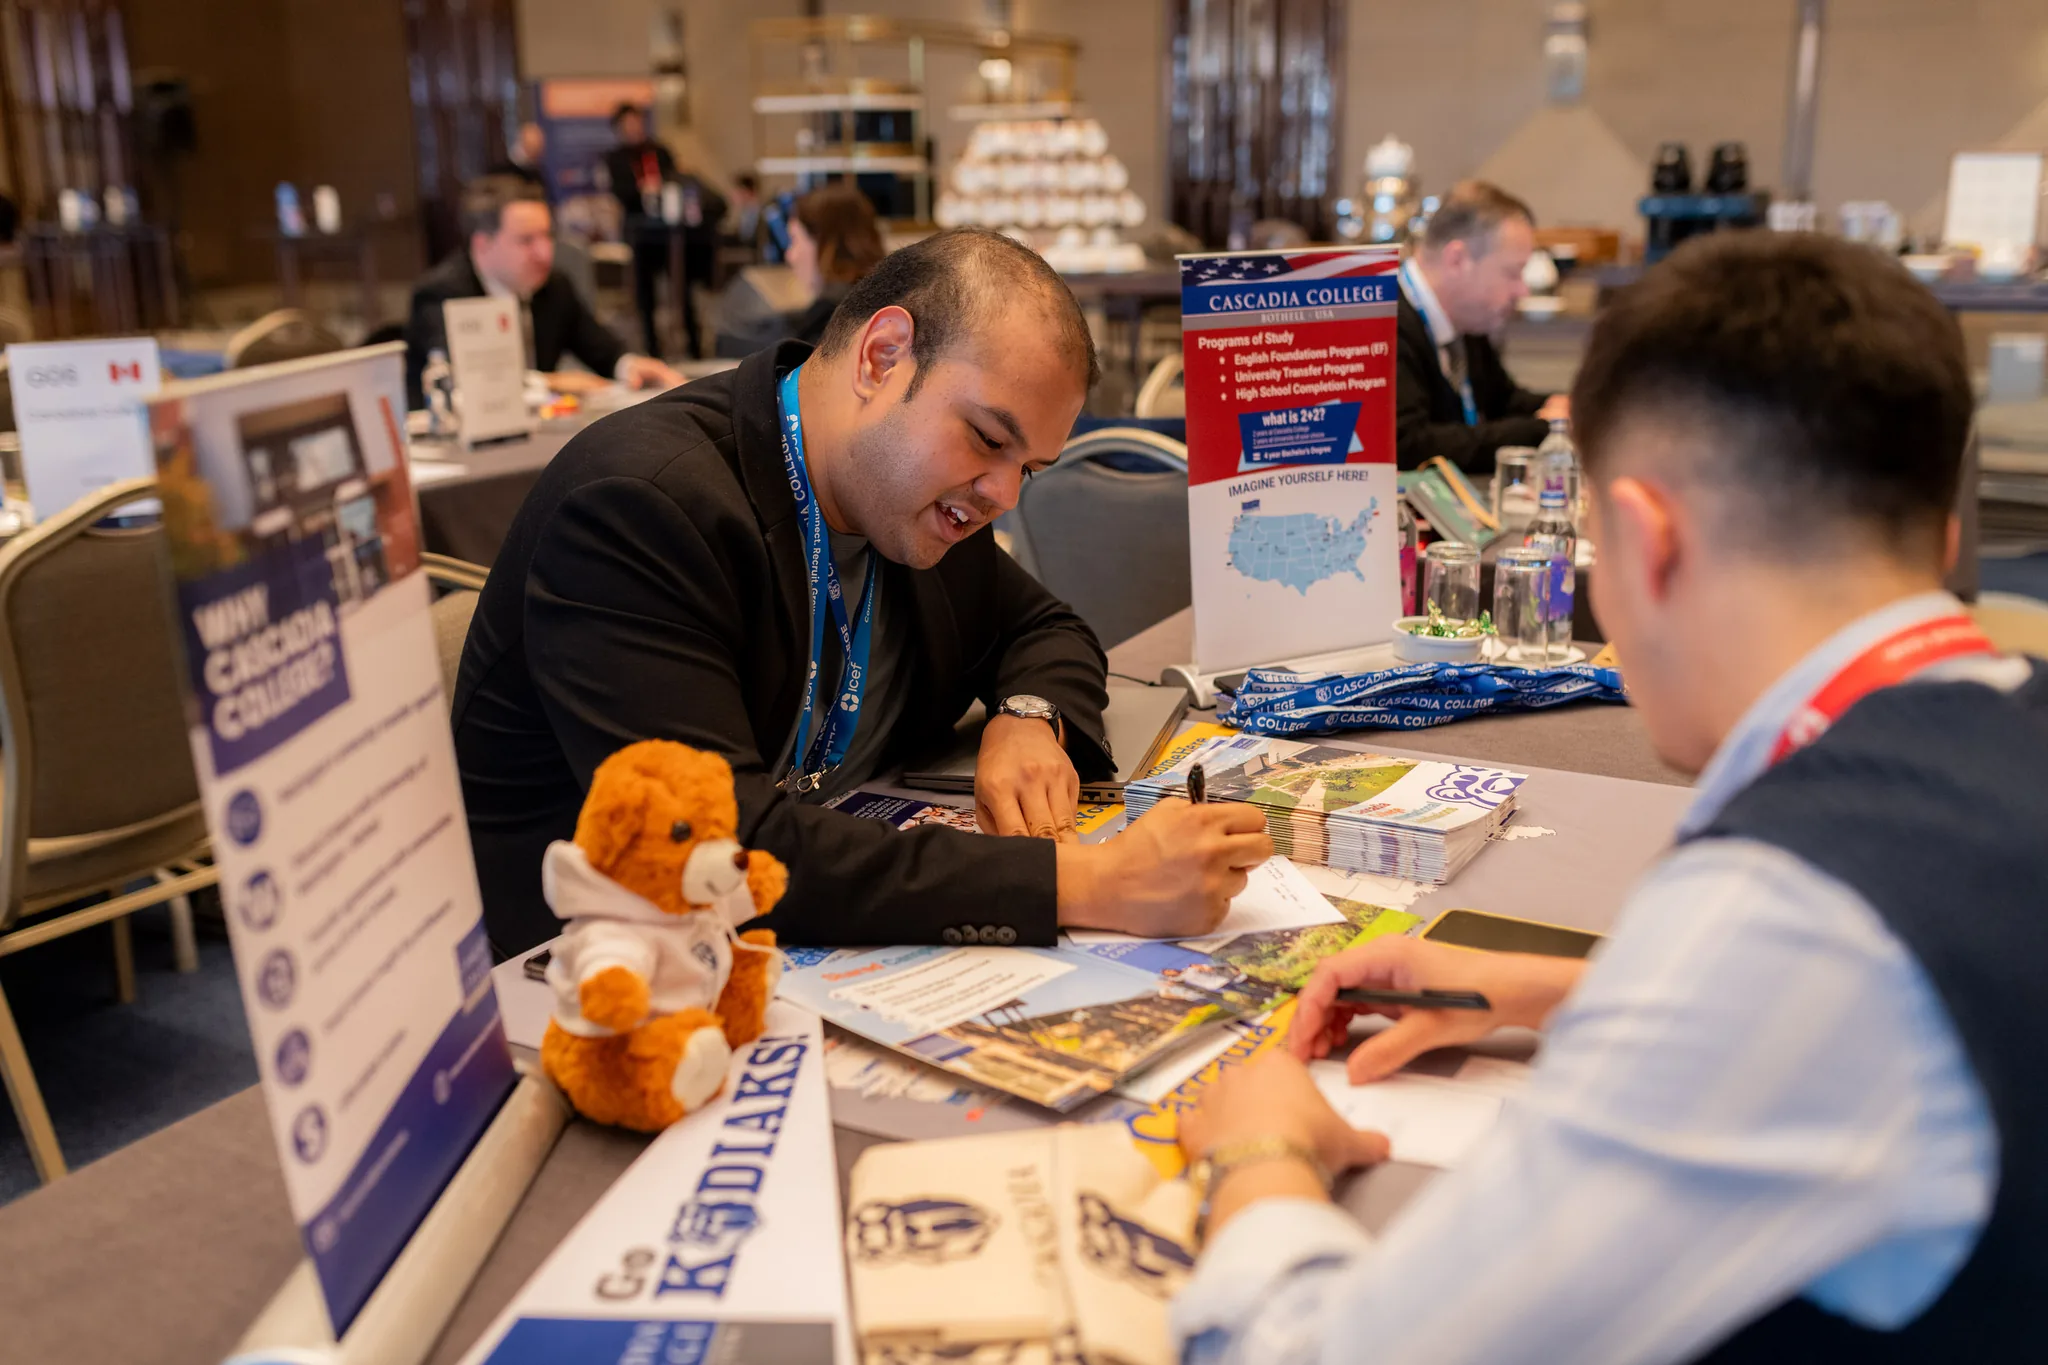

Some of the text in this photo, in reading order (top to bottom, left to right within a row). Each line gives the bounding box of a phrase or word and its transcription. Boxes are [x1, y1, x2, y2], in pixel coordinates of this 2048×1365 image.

[1209, 285, 1385, 312] CASCADIA COLLEGE
[1261, 309, 1335, 324] BOTHELL USA
[1198, 330, 1295, 351] Programs of Study
[1234, 341, 1389, 367] English Foundations Program (EF)
[1235, 362, 1365, 383] University Transfer Program
[1236, 377, 1387, 402] High School Completion Program
[1262, 406, 1326, 427] what is 2+2?
[1269, 450, 1281, 461] year
[1281, 447, 1310, 458] Bachelor's
[1310, 445, 1332, 456] Degree
[1228, 470, 1369, 497] IMAGINE YOURSELF HERE!
[192, 582, 269, 651] WHY
[203, 600, 335, 697] CASCADIA
[848, 661, 863, 693] icef
[1334, 671, 1392, 697] CASCADIA
[1378, 697, 1494, 710] CASCADIA COLLEGE
[1340, 713, 1454, 727] CASCADIA COLLEGE
[594, 1247, 658, 1305] Go
